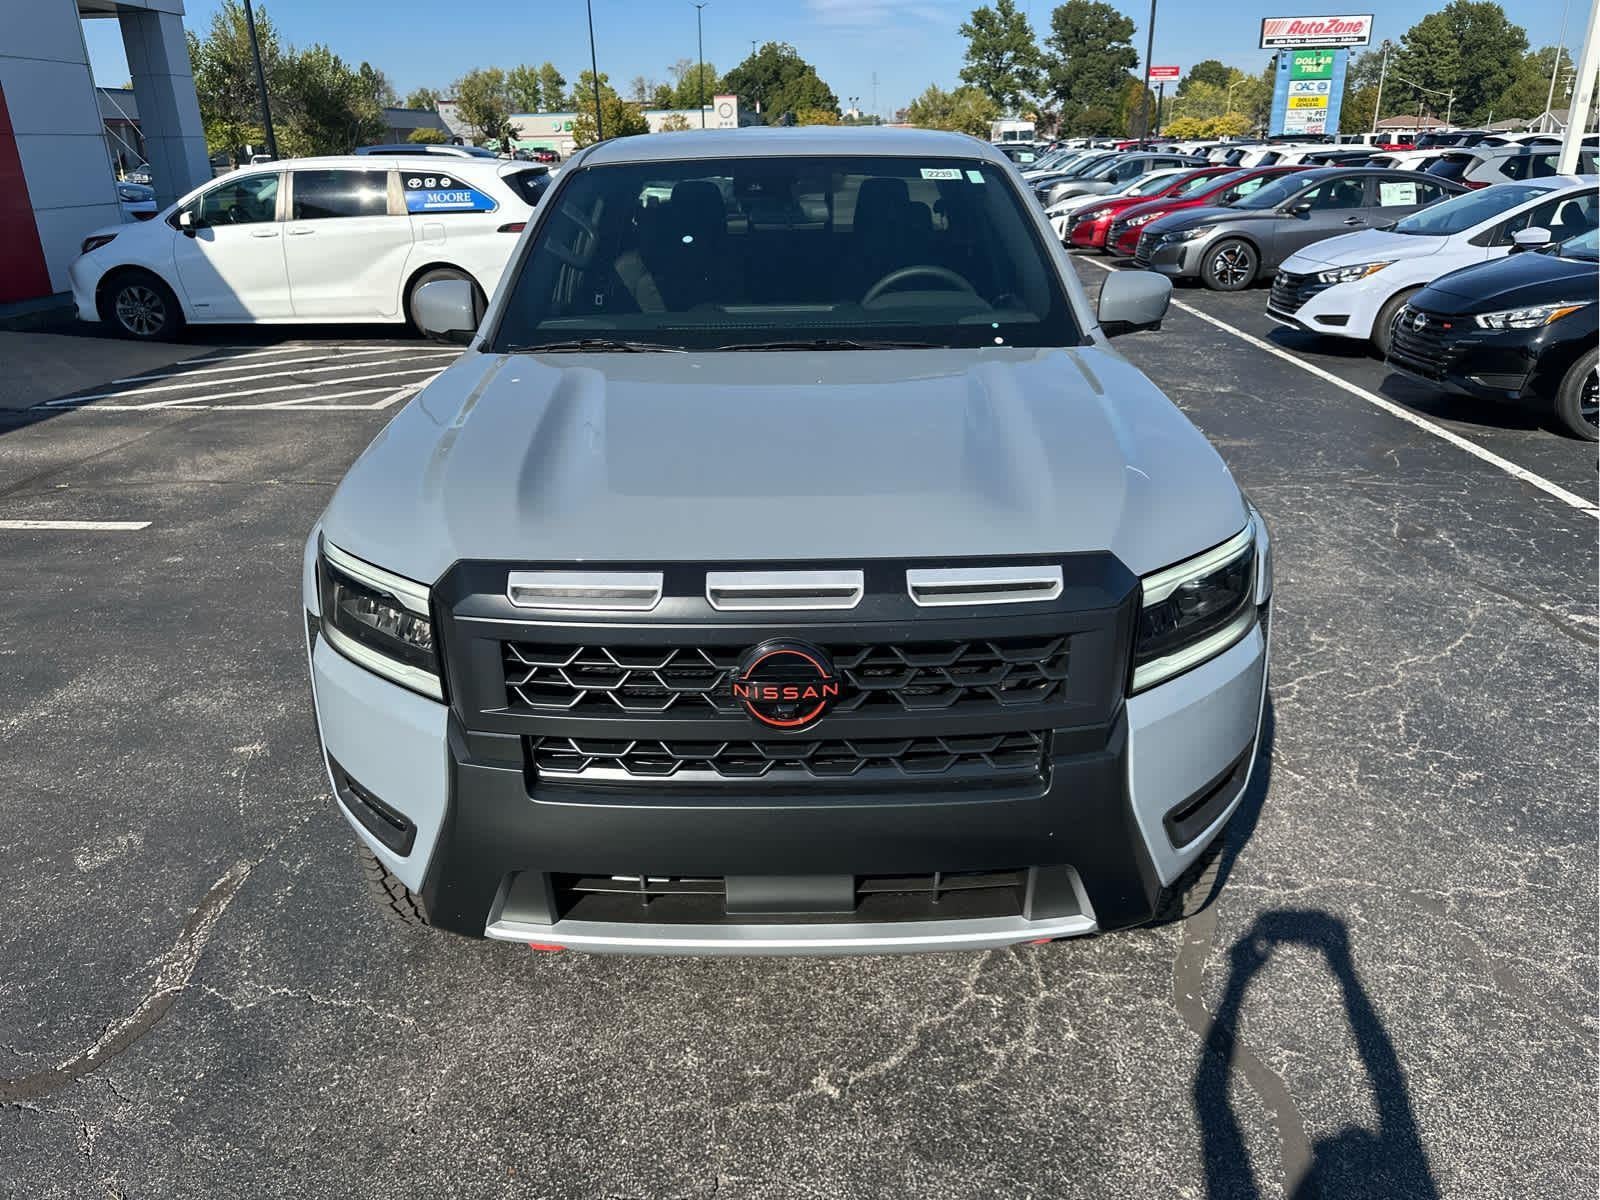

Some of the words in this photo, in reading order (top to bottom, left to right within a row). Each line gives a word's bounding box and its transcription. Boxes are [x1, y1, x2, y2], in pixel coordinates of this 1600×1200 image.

[1287, 19, 1364, 35] AutoZone
[1295, 57, 1333, 65] DOLLAR
[1301, 65, 1324, 73] TREE
[427, 192, 472, 202] MOORE
[733, 682, 839, 700] NISSAN
